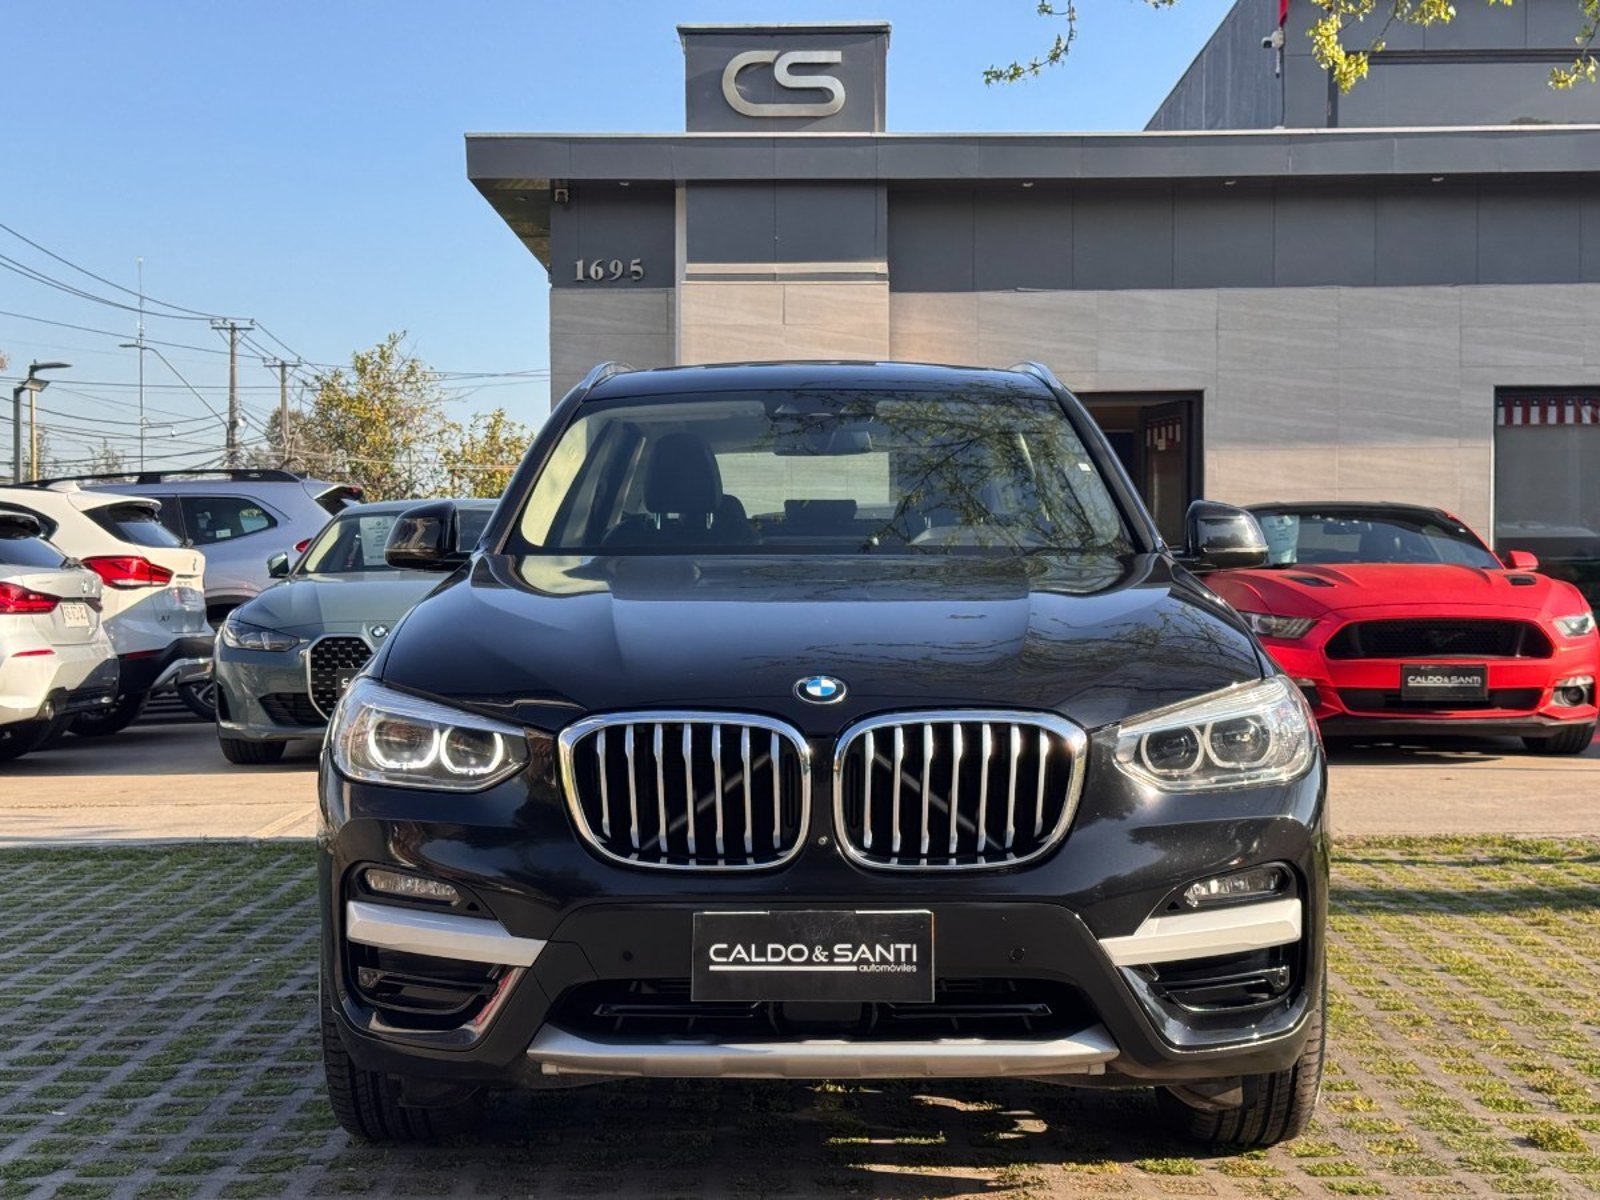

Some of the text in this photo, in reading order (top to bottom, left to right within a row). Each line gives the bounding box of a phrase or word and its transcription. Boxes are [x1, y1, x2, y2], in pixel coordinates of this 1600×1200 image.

[722, 50, 846, 117] CS
[575, 258, 644, 281] 1695
[858, 963, 917, 973] automóviles
